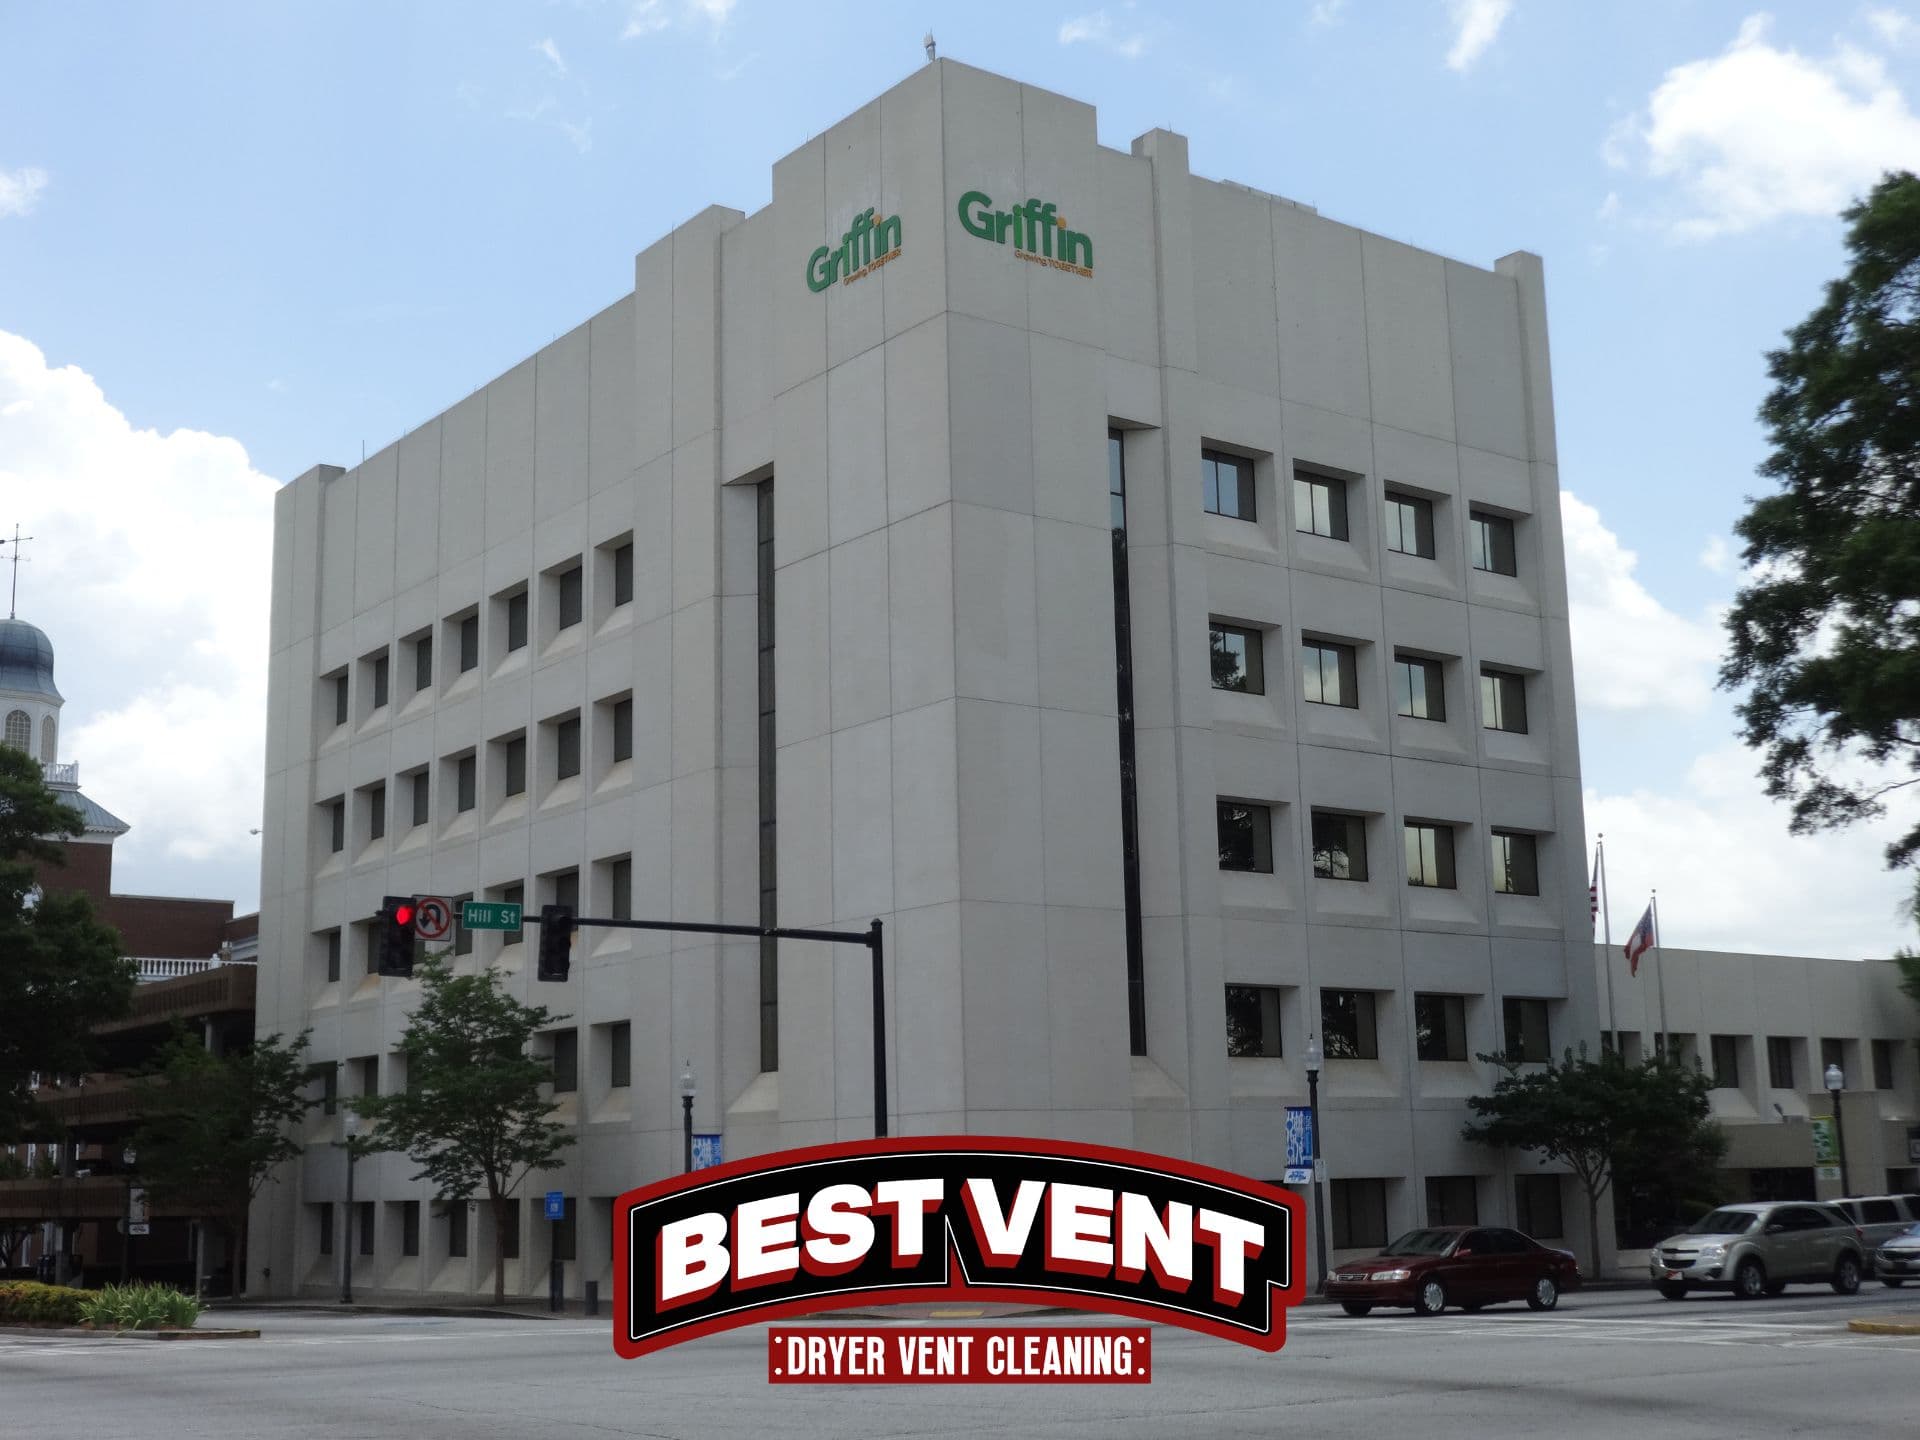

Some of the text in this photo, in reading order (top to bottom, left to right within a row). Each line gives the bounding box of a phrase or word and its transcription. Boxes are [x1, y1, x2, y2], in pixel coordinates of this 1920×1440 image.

[806, 206, 902, 293] Griffin
[957, 190, 1094, 269] Griffin
[468, 909, 516, 924] Hill St
